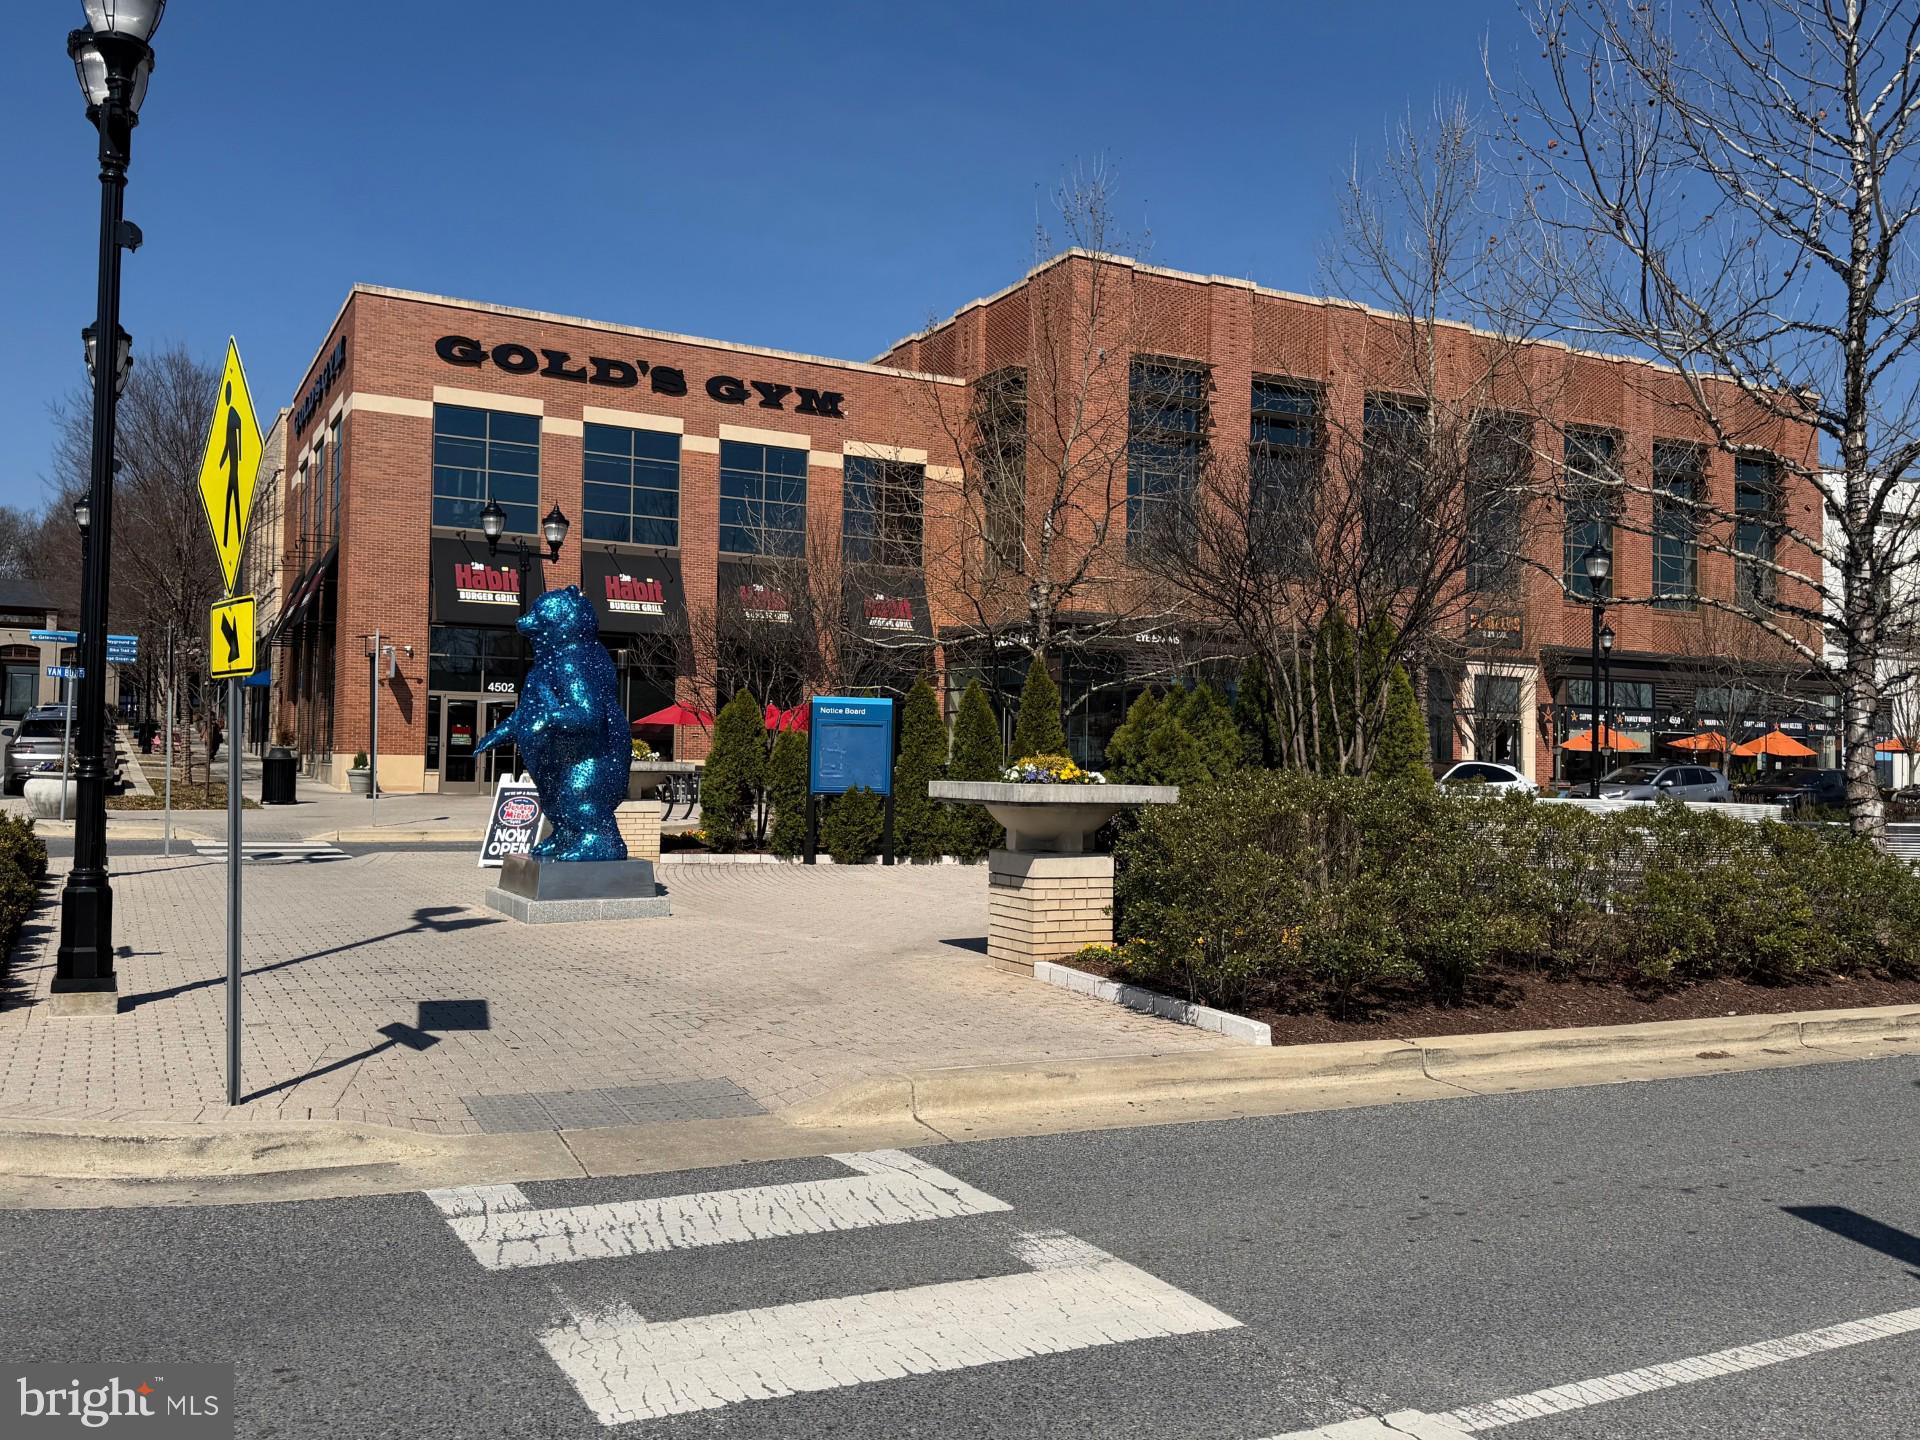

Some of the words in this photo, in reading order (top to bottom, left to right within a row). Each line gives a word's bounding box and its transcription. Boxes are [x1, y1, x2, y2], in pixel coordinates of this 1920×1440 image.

[435, 335, 688, 397] GOLD'S
[705, 375, 845, 418] GYM
[455, 563, 520, 592] Habit
[605, 575, 663, 602] Habit
[459, 591, 493, 601] BURGER
[495, 593, 518, 603] GRILL
[609, 601, 640, 611] BURGER
[641, 603, 663, 613] GRILL
[1135, 634, 1150, 642] EYE
[47, 667, 62, 676] VAN
[487, 682, 514, 692] 4502
[844, 707, 866, 715] Board
[504, 801, 534, 813] Jersey
[494, 829, 531, 842] NOW
[488, 842, 530, 855] OPEN
